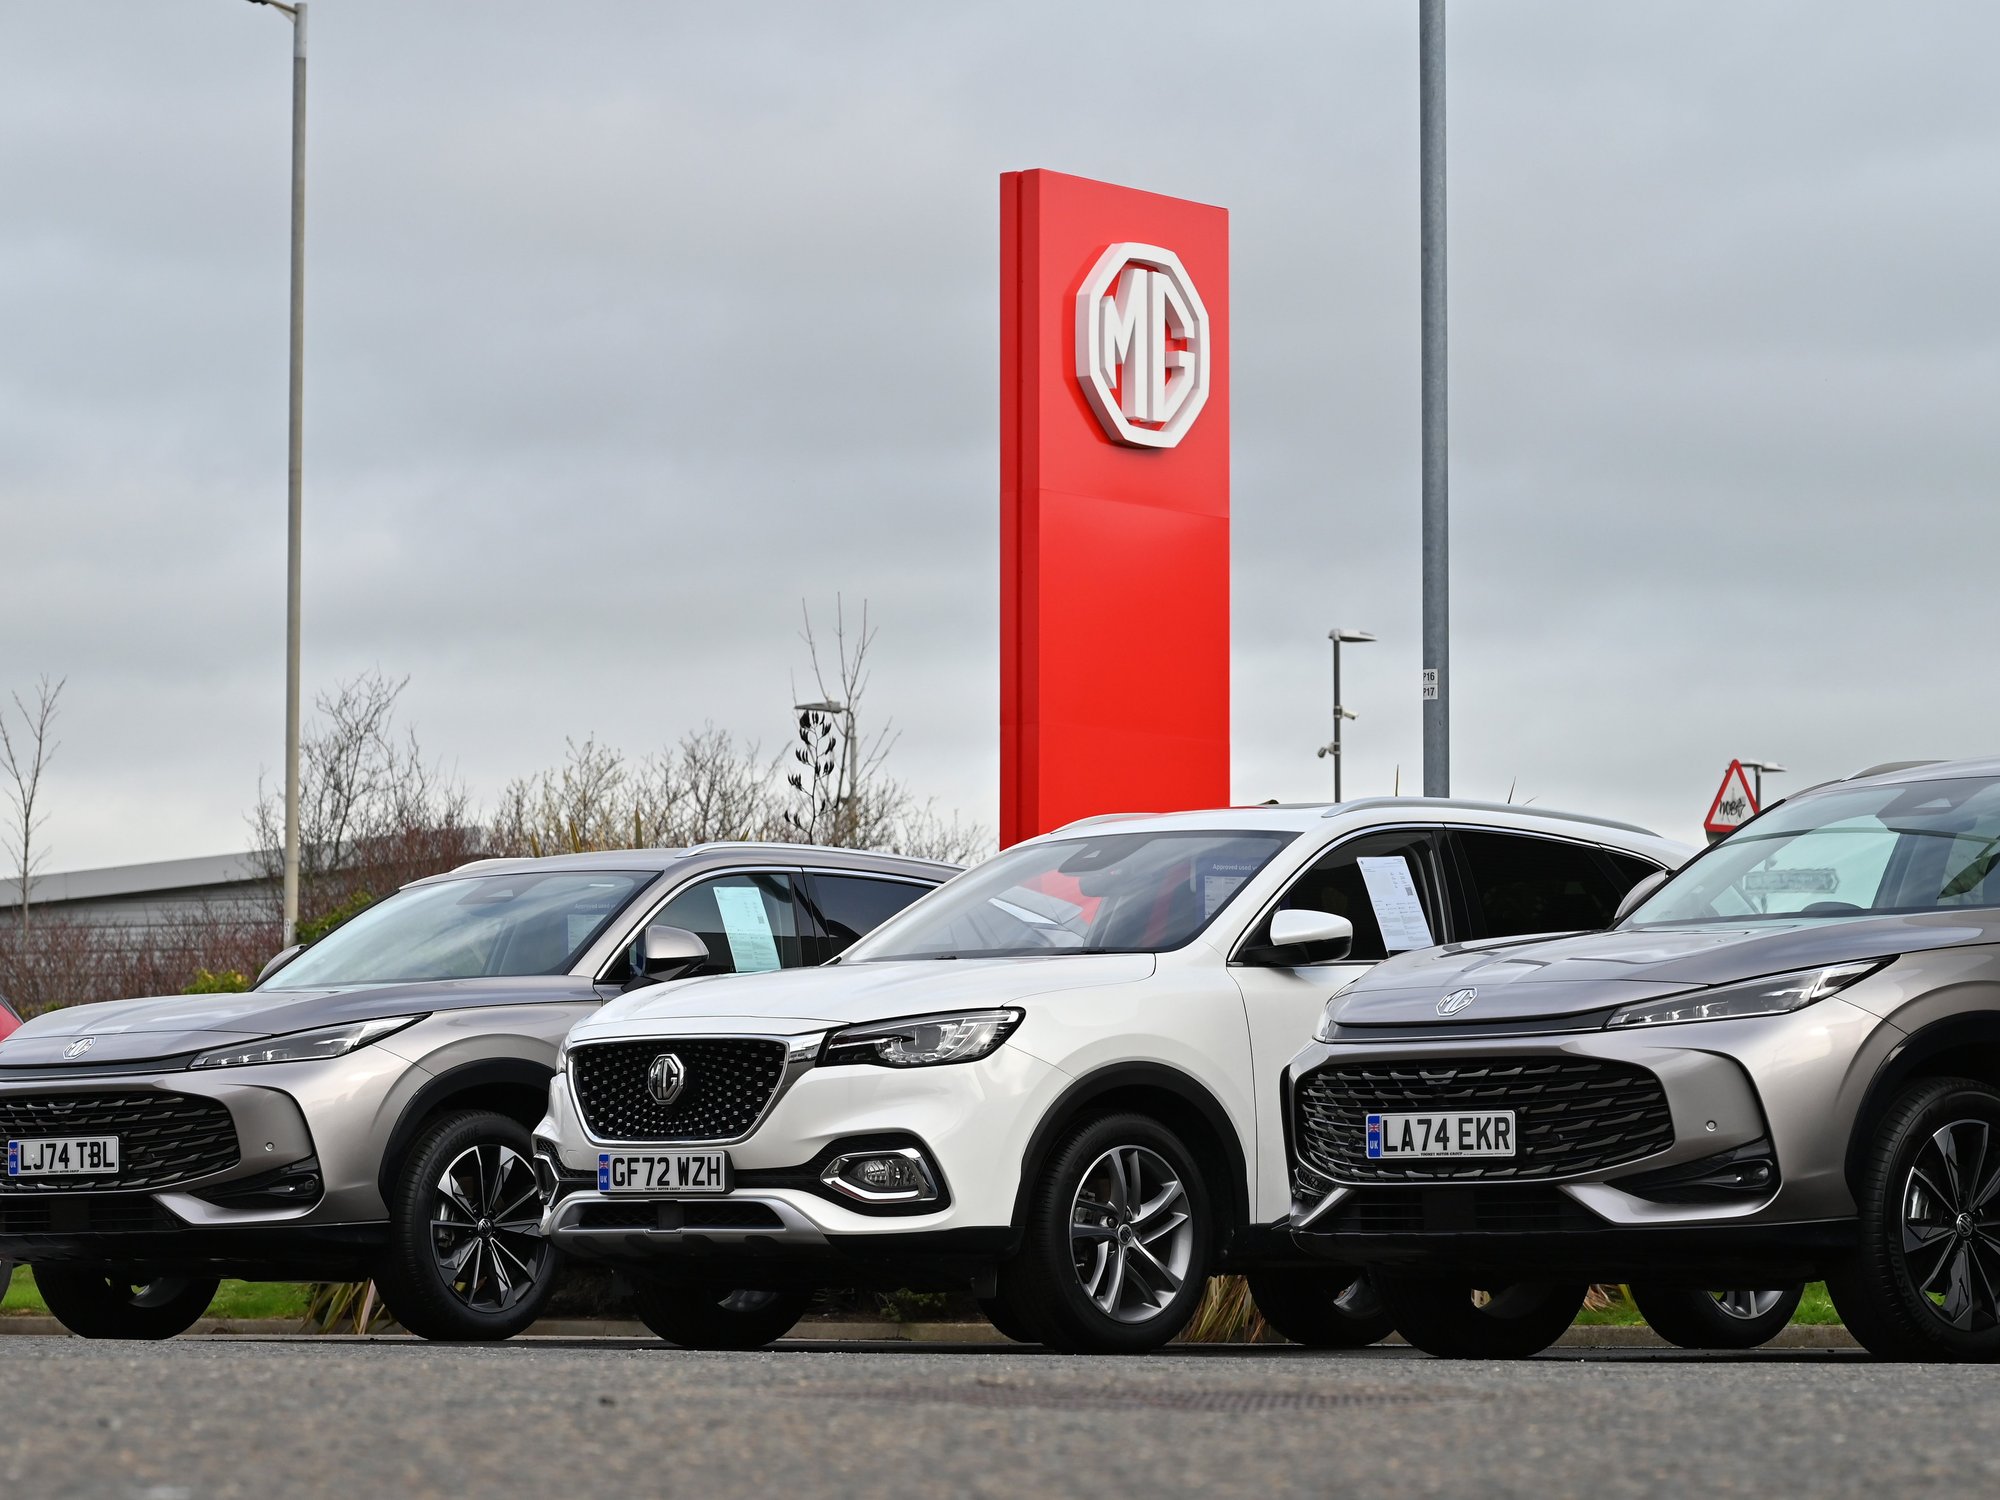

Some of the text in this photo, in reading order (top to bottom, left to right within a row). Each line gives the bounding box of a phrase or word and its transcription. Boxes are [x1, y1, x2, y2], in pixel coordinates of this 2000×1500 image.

[1101, 266, 1196, 423] MG
[1213, 863, 1238, 871] Approved
[1369, 1141, 1379, 1149] UK
[1383, 1117, 1510, 1152] LA74 EKR
[21, 1141, 115, 1170] LJ74 TBL
[599, 1175, 608, 1183] UK
[612, 1157, 721, 1186] GF72 WZH
